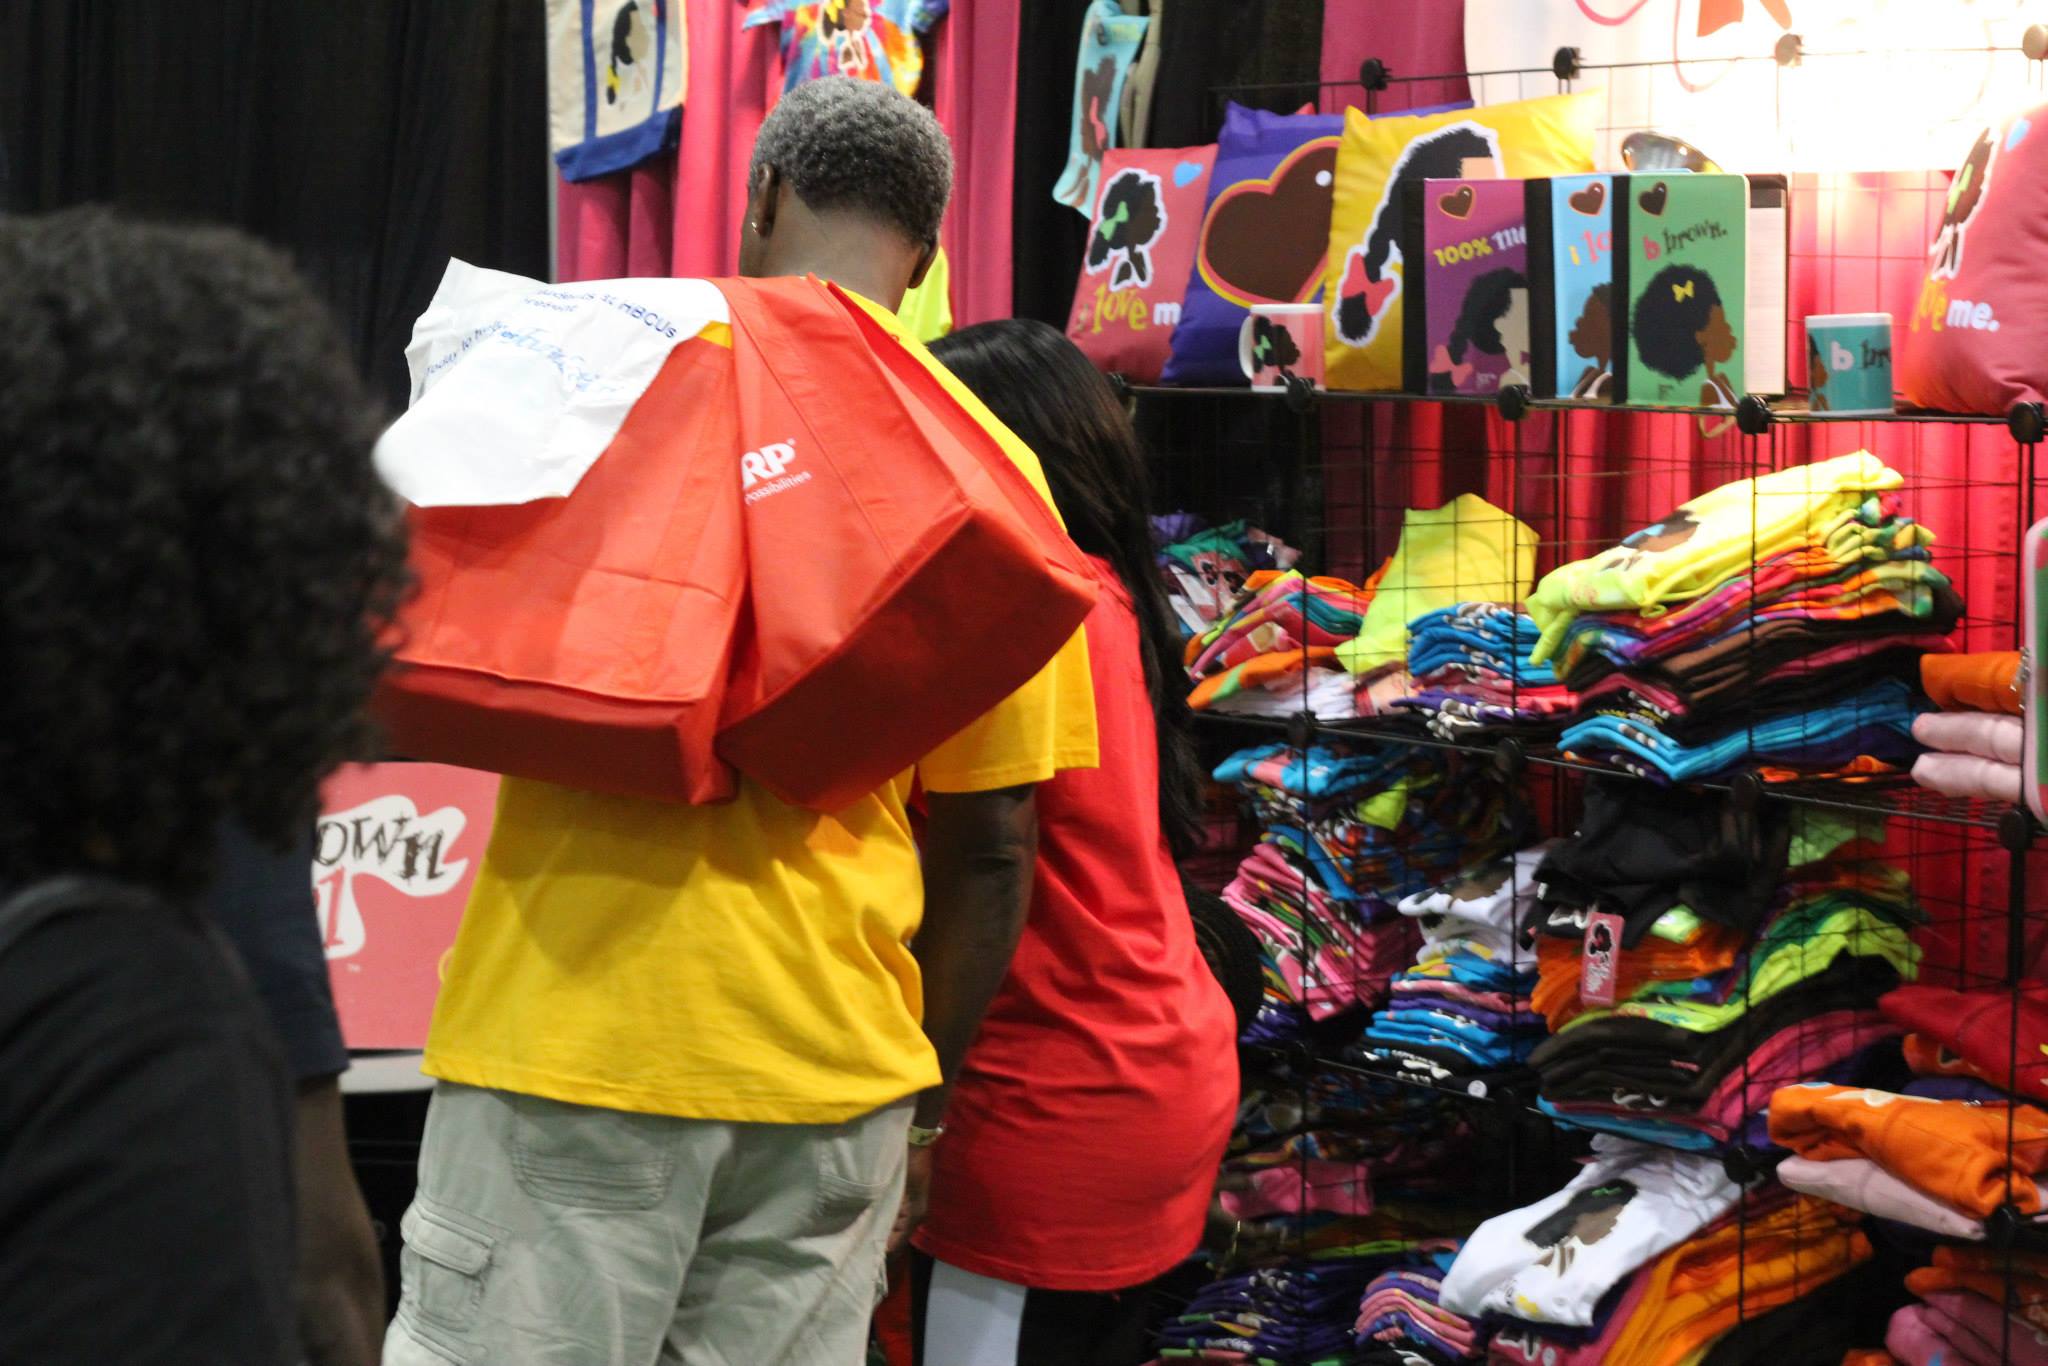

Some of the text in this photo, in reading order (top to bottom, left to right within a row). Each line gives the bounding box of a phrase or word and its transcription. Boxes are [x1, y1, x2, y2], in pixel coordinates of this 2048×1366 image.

[1433, 236, 1493, 267] 100%
[1091, 283, 1147, 334] love
[1946, 299, 2000, 332] me.
[1831, 340, 1855, 371] b
